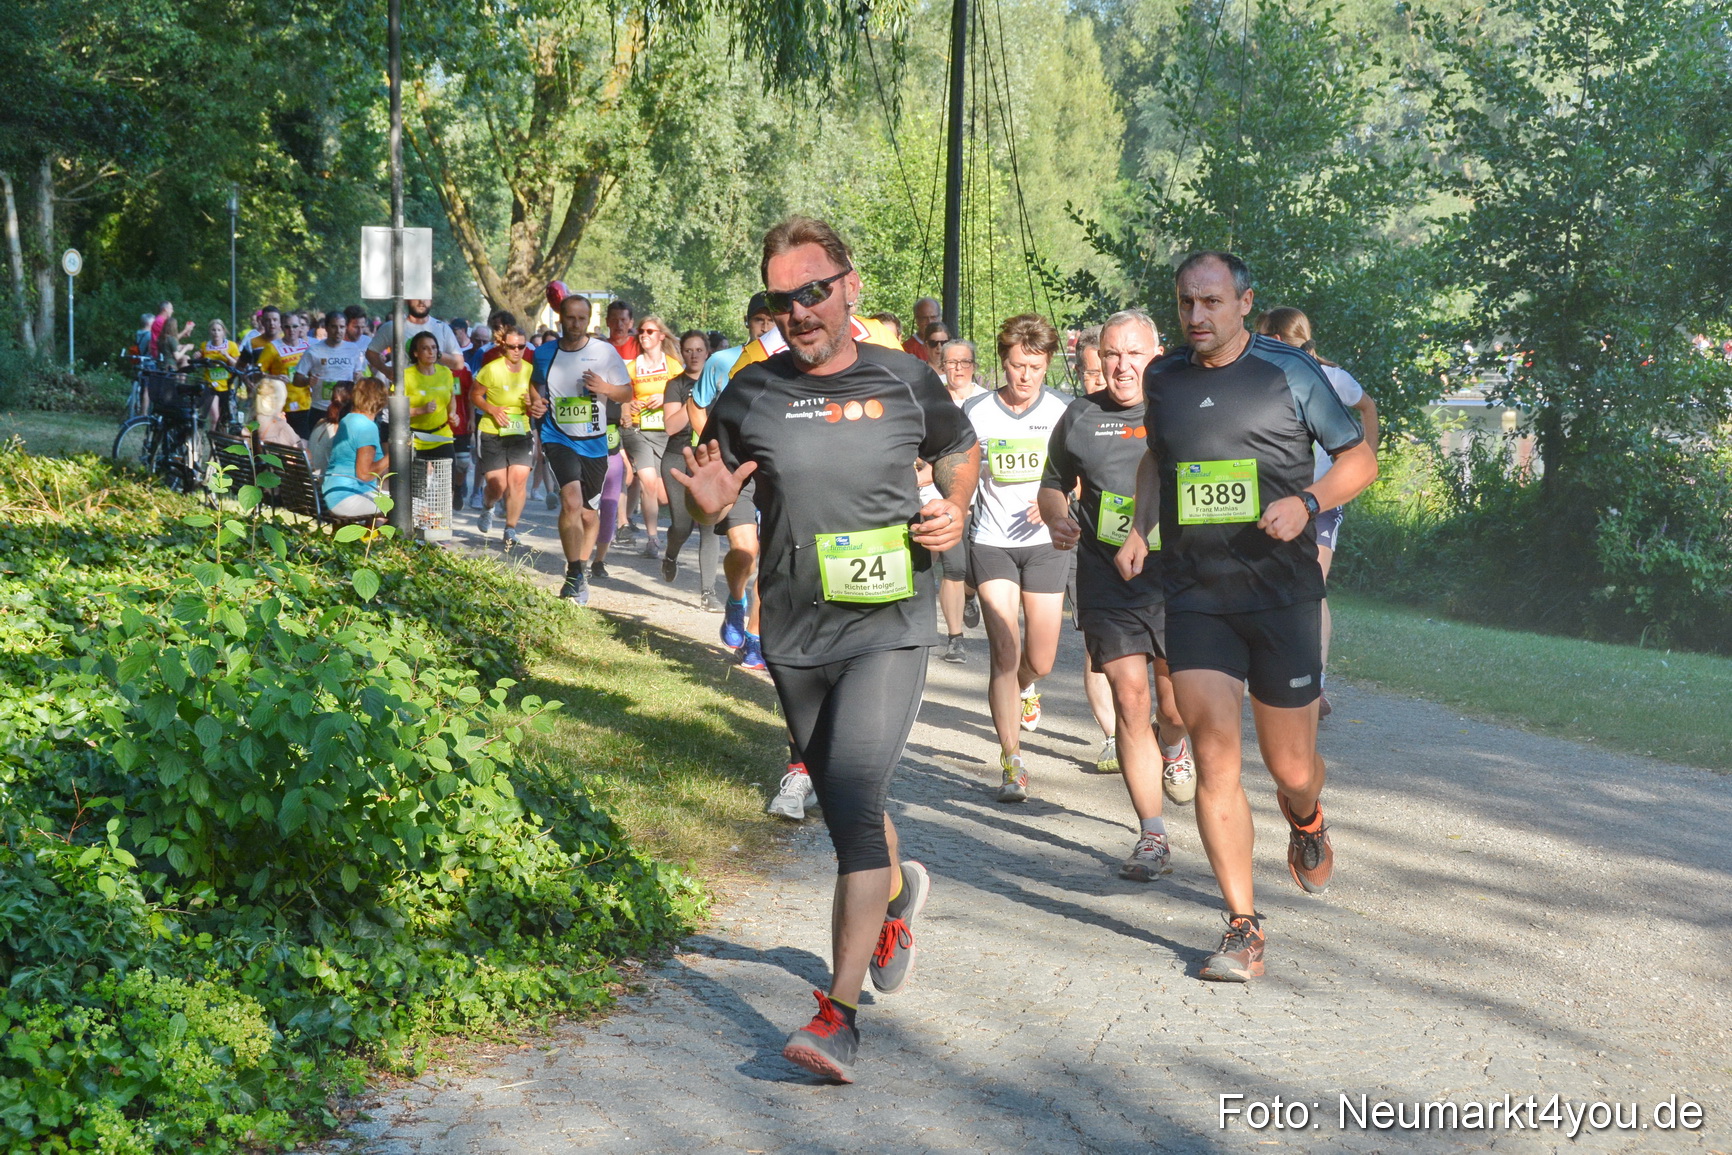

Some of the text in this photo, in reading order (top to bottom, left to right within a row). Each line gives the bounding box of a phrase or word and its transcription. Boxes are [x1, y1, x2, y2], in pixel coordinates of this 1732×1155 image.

[792, 398, 826, 407] APTIV
[559, 406, 587, 417] 2104
[995, 453, 1039, 470] 1916
[1186, 483, 1247, 506] 1389
[1116, 515, 1131, 534] 2
[850, 555, 887, 583] 24
[844, 581, 895, 591] Richter Holger
[864, 588, 895, 596] Deutschland
